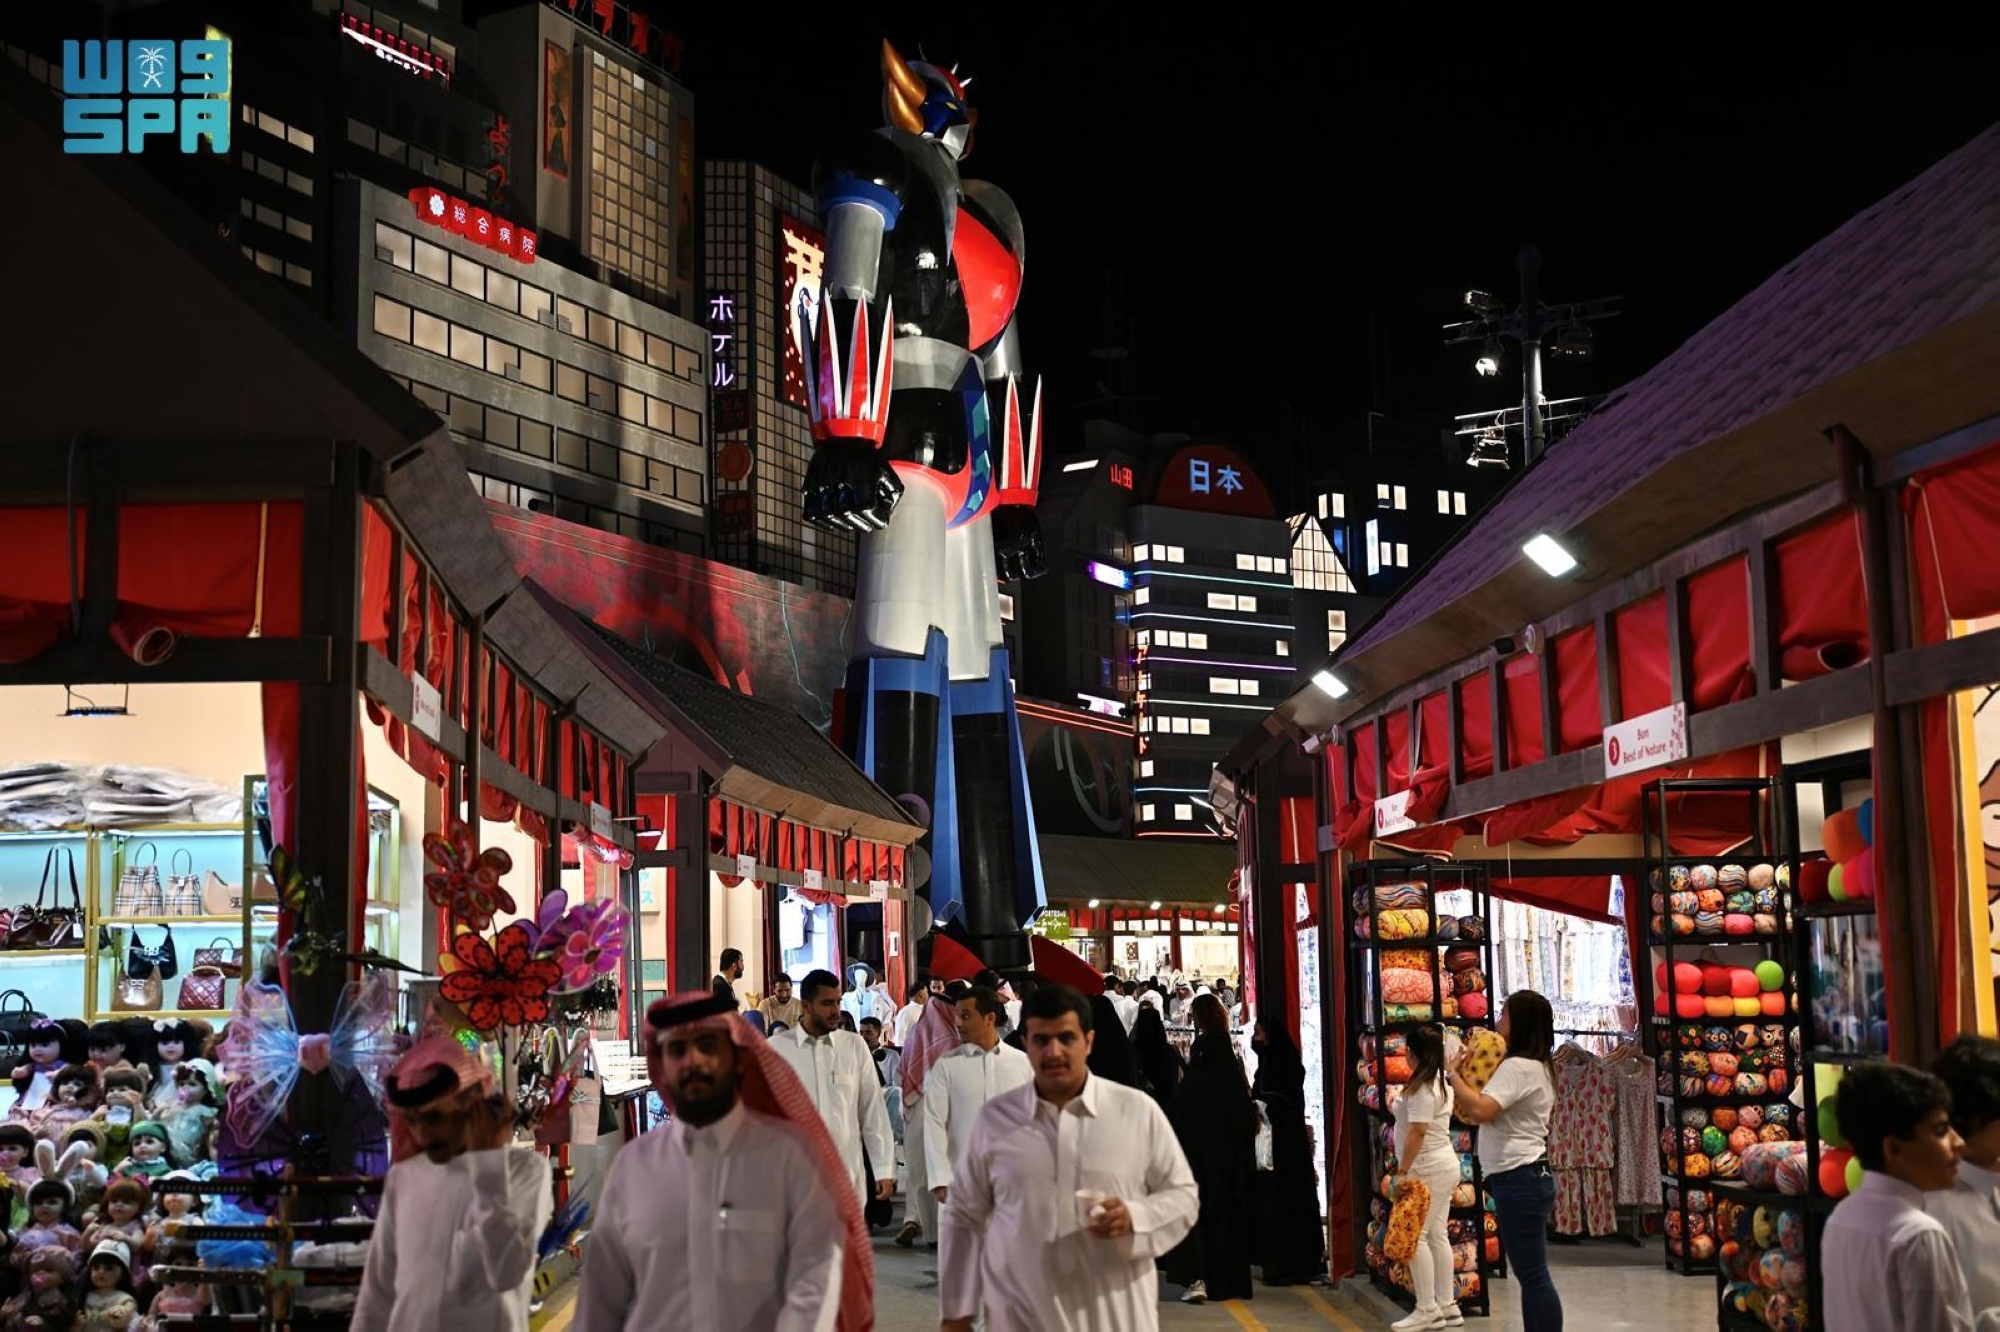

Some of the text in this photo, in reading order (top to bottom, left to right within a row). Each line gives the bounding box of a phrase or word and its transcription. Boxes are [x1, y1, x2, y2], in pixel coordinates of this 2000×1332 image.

[454, 205, 534, 255] 総合病院
[709, 295, 735, 387] ホテル
[1110, 464, 1133, 491] 山田
[1189, 458, 1244, 495] 日本
[1637, 728, 1649, 741] Bon
[1623, 742, 1666, 764] Best of Nature
